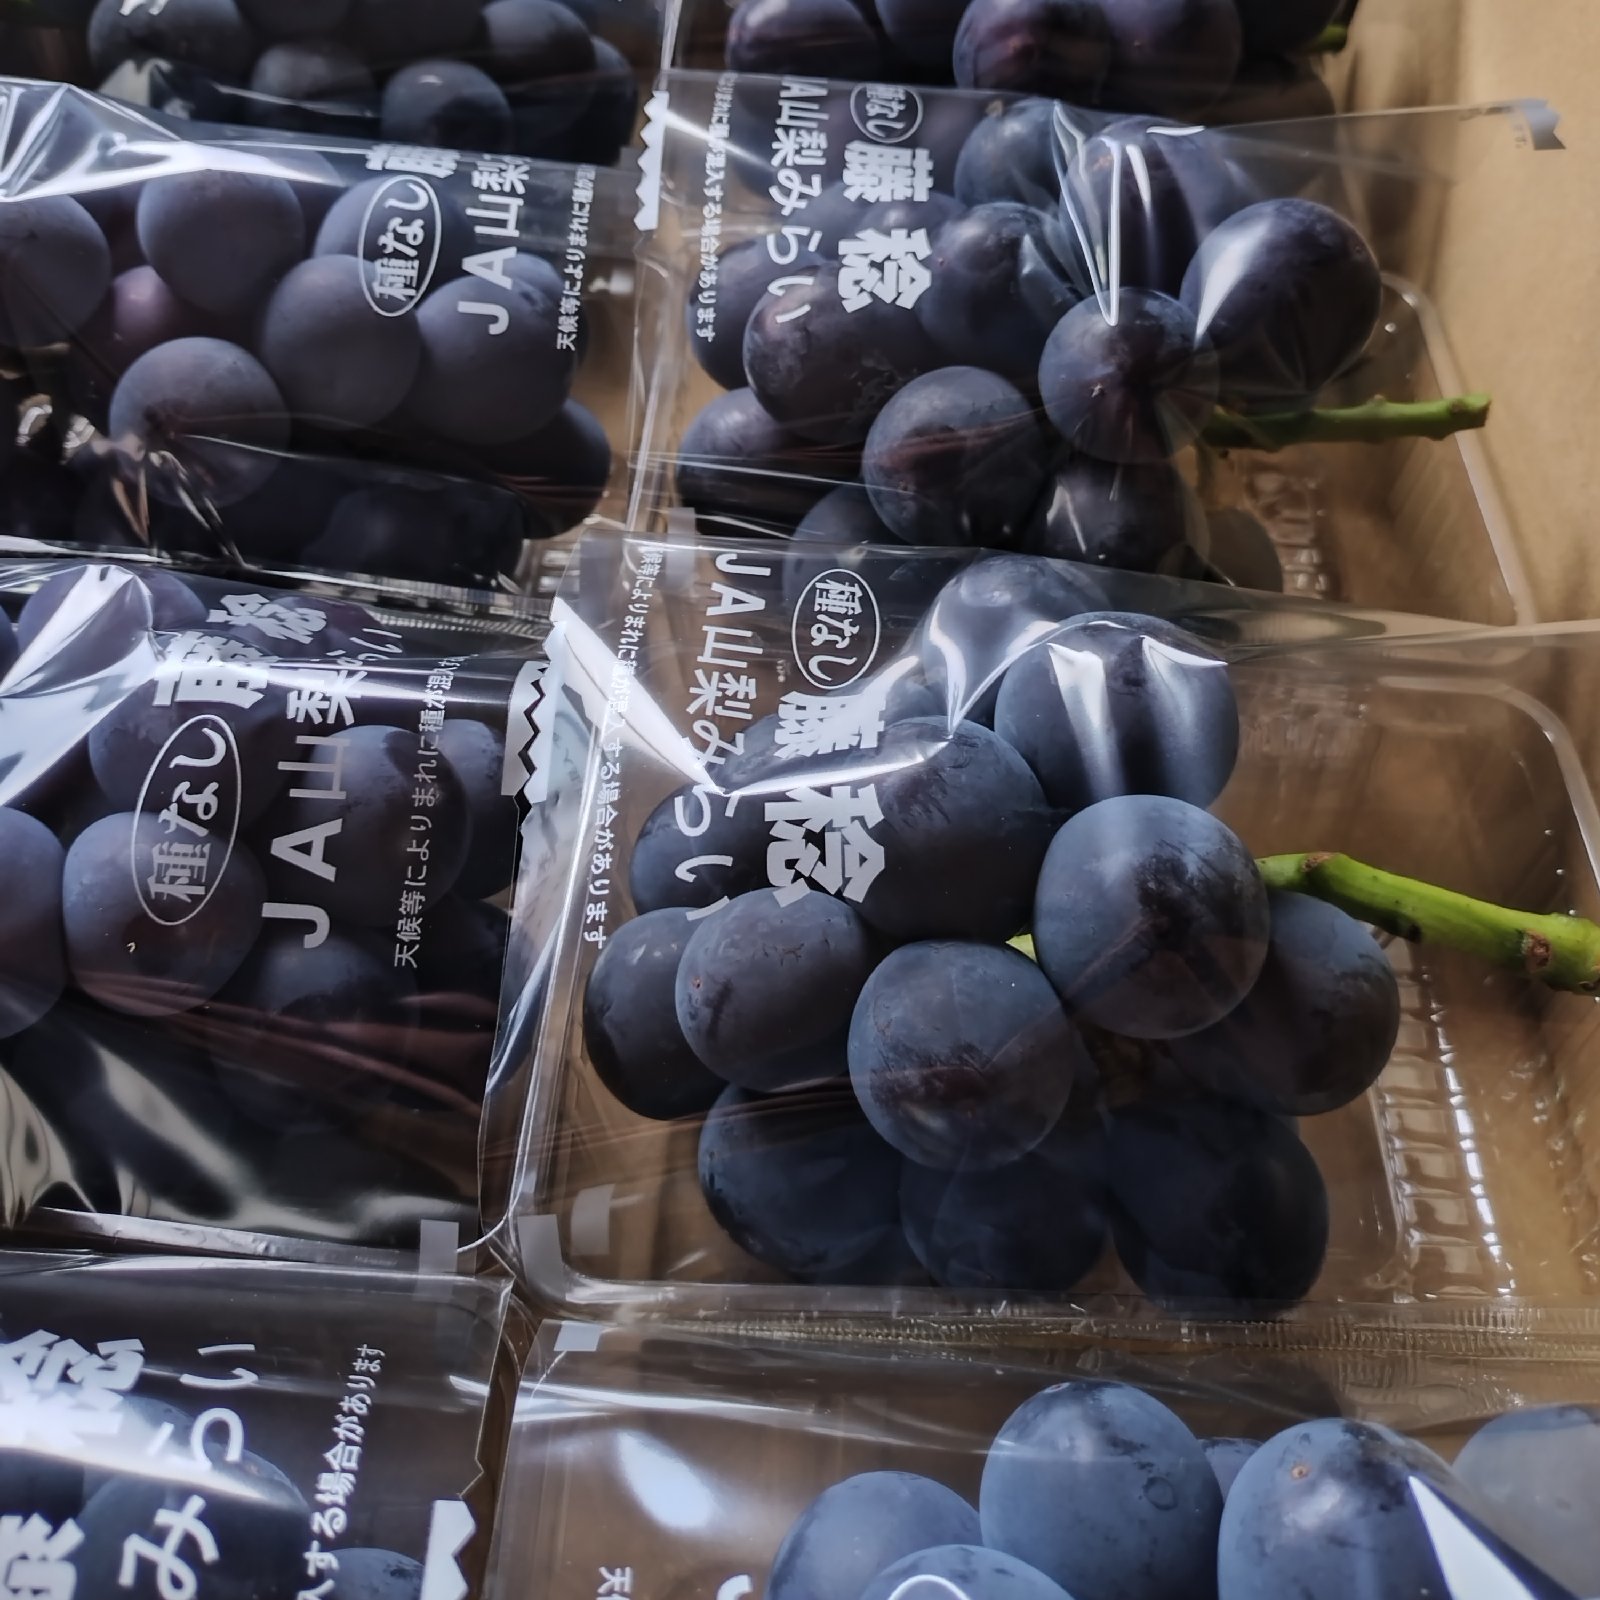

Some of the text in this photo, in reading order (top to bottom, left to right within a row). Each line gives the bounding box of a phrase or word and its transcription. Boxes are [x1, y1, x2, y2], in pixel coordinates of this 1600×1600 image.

[372, 182, 430, 301] 種なし
[838, 140, 934, 313] 藤稔
[808, 578, 863, 682] 種なし
[147, 727, 227, 902] 種なし
[674, 552, 772, 921] JA山梨みらい
[764, 690, 886, 908] 藤稔
